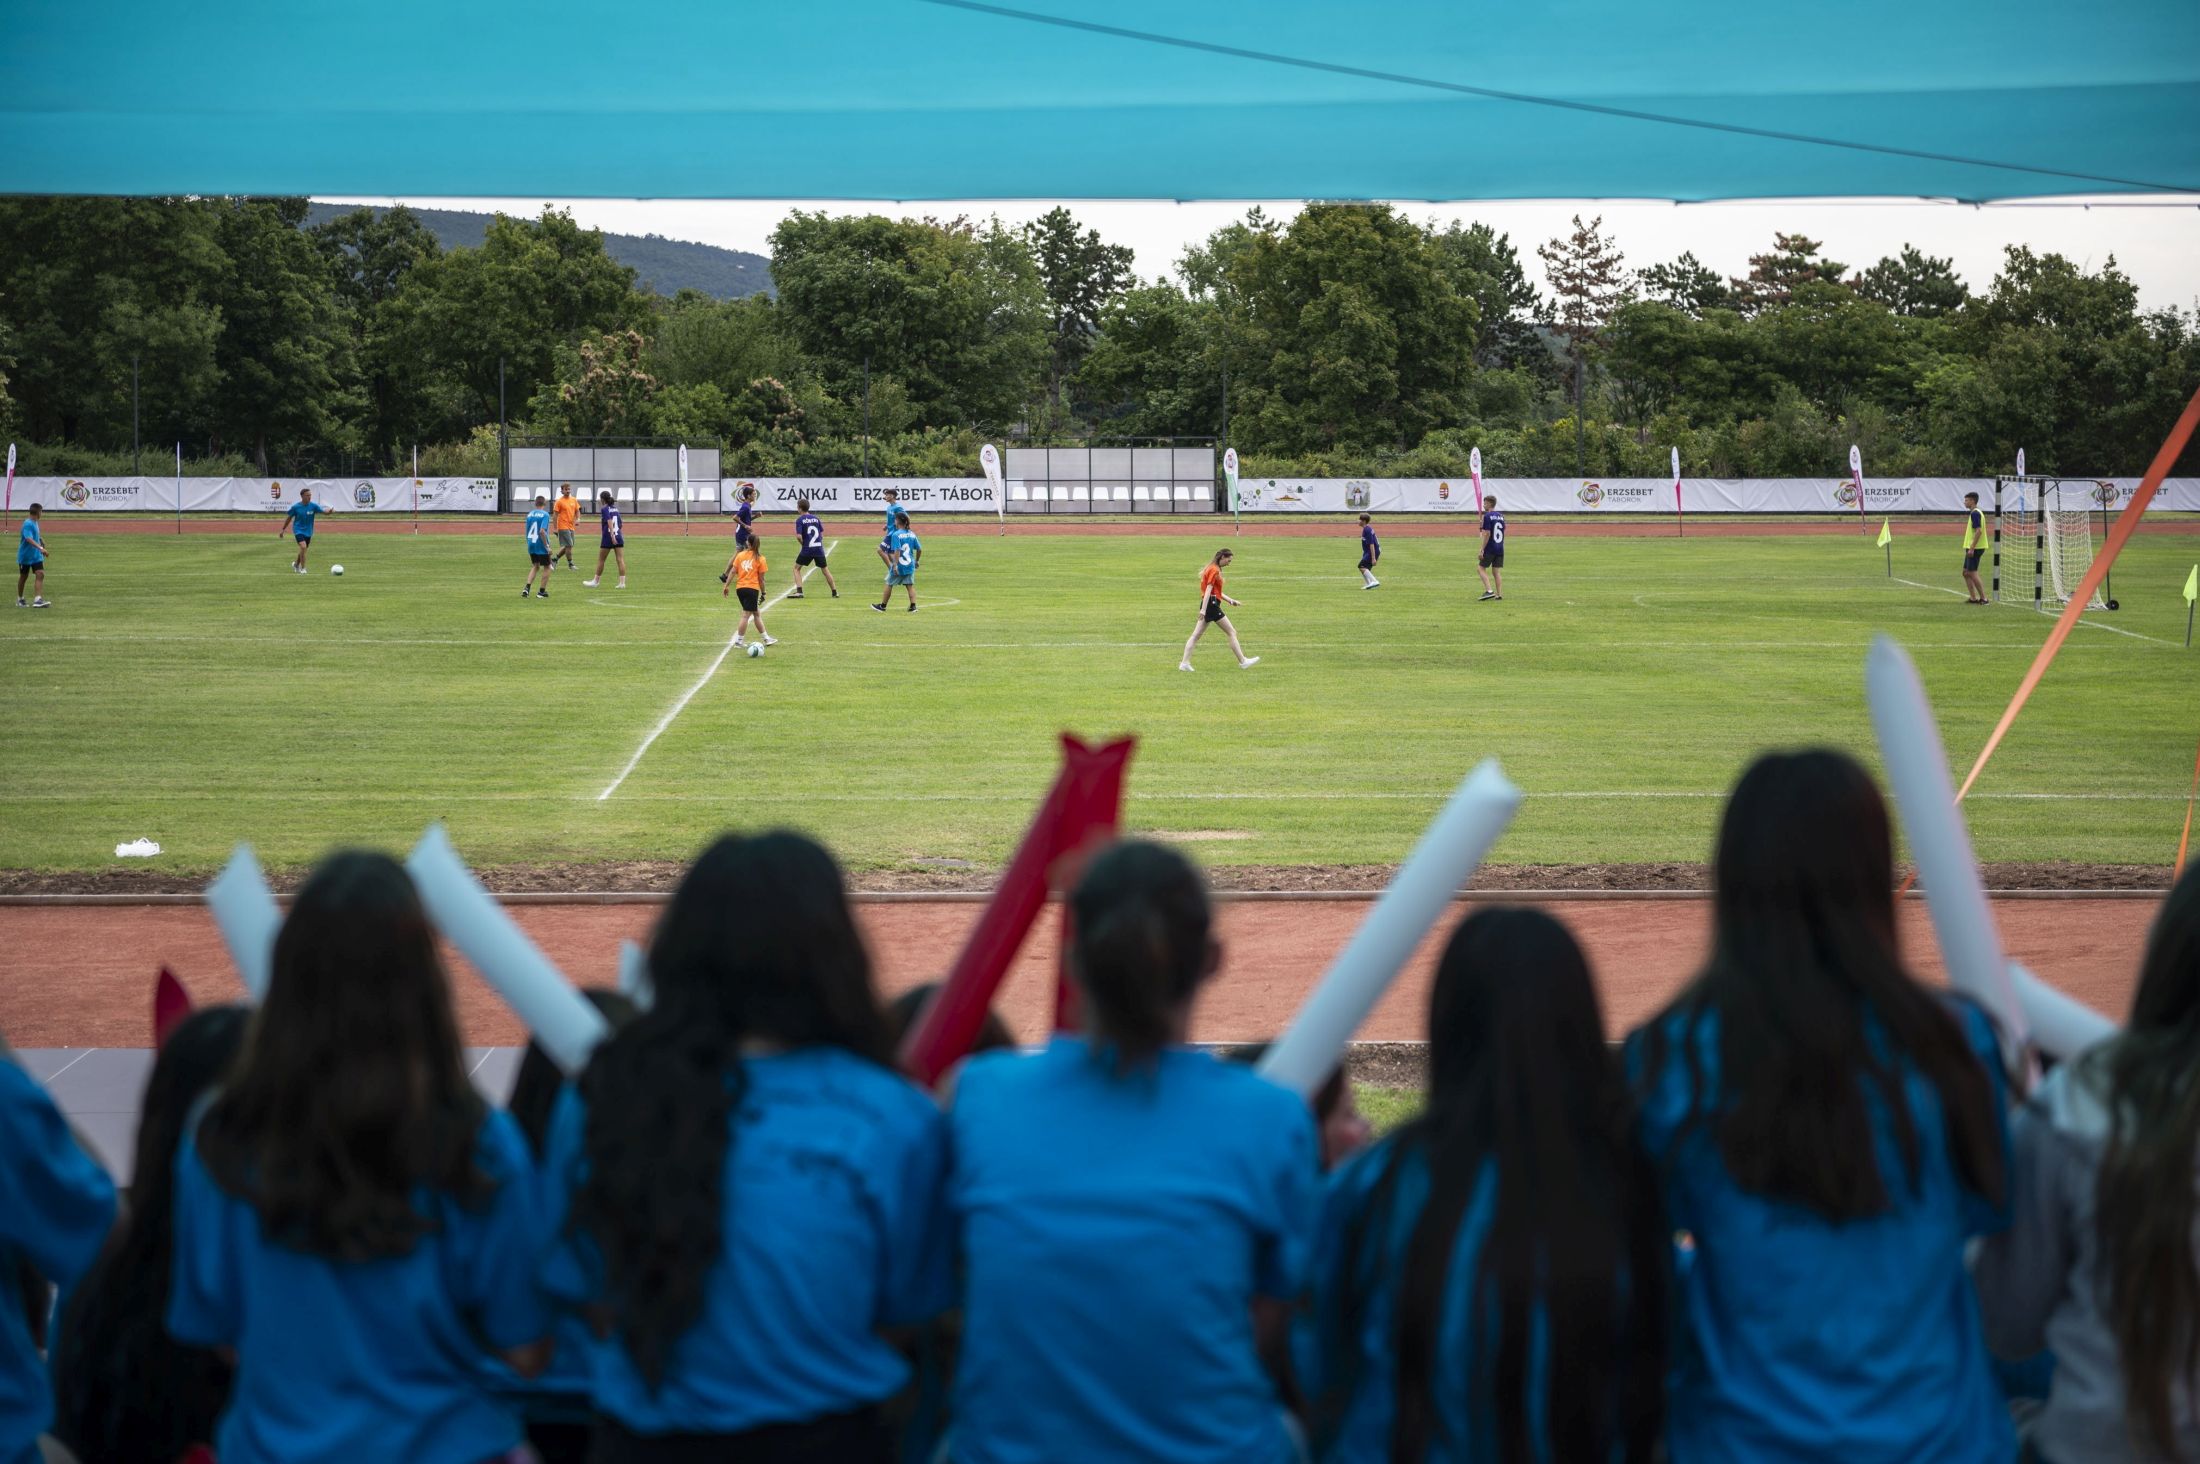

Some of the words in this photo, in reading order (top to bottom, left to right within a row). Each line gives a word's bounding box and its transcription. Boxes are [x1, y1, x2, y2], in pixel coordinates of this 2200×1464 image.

[92, 487, 140, 495] ERZSÉBET
[777, 485, 838, 501] ZÁNKAI
[939, 485, 993, 501] TÁBOR
[1607, 487, 1654, 496] ERZSÉBET
[1864, 487, 1911, 496] ERZSÉBET
[2122, 487, 2168, 496] ERZET
[527, 521, 539, 544] 4
[807, 525, 822, 548] 2
[1493, 522, 1504, 544] 6
[899, 543, 912, 566] 3
